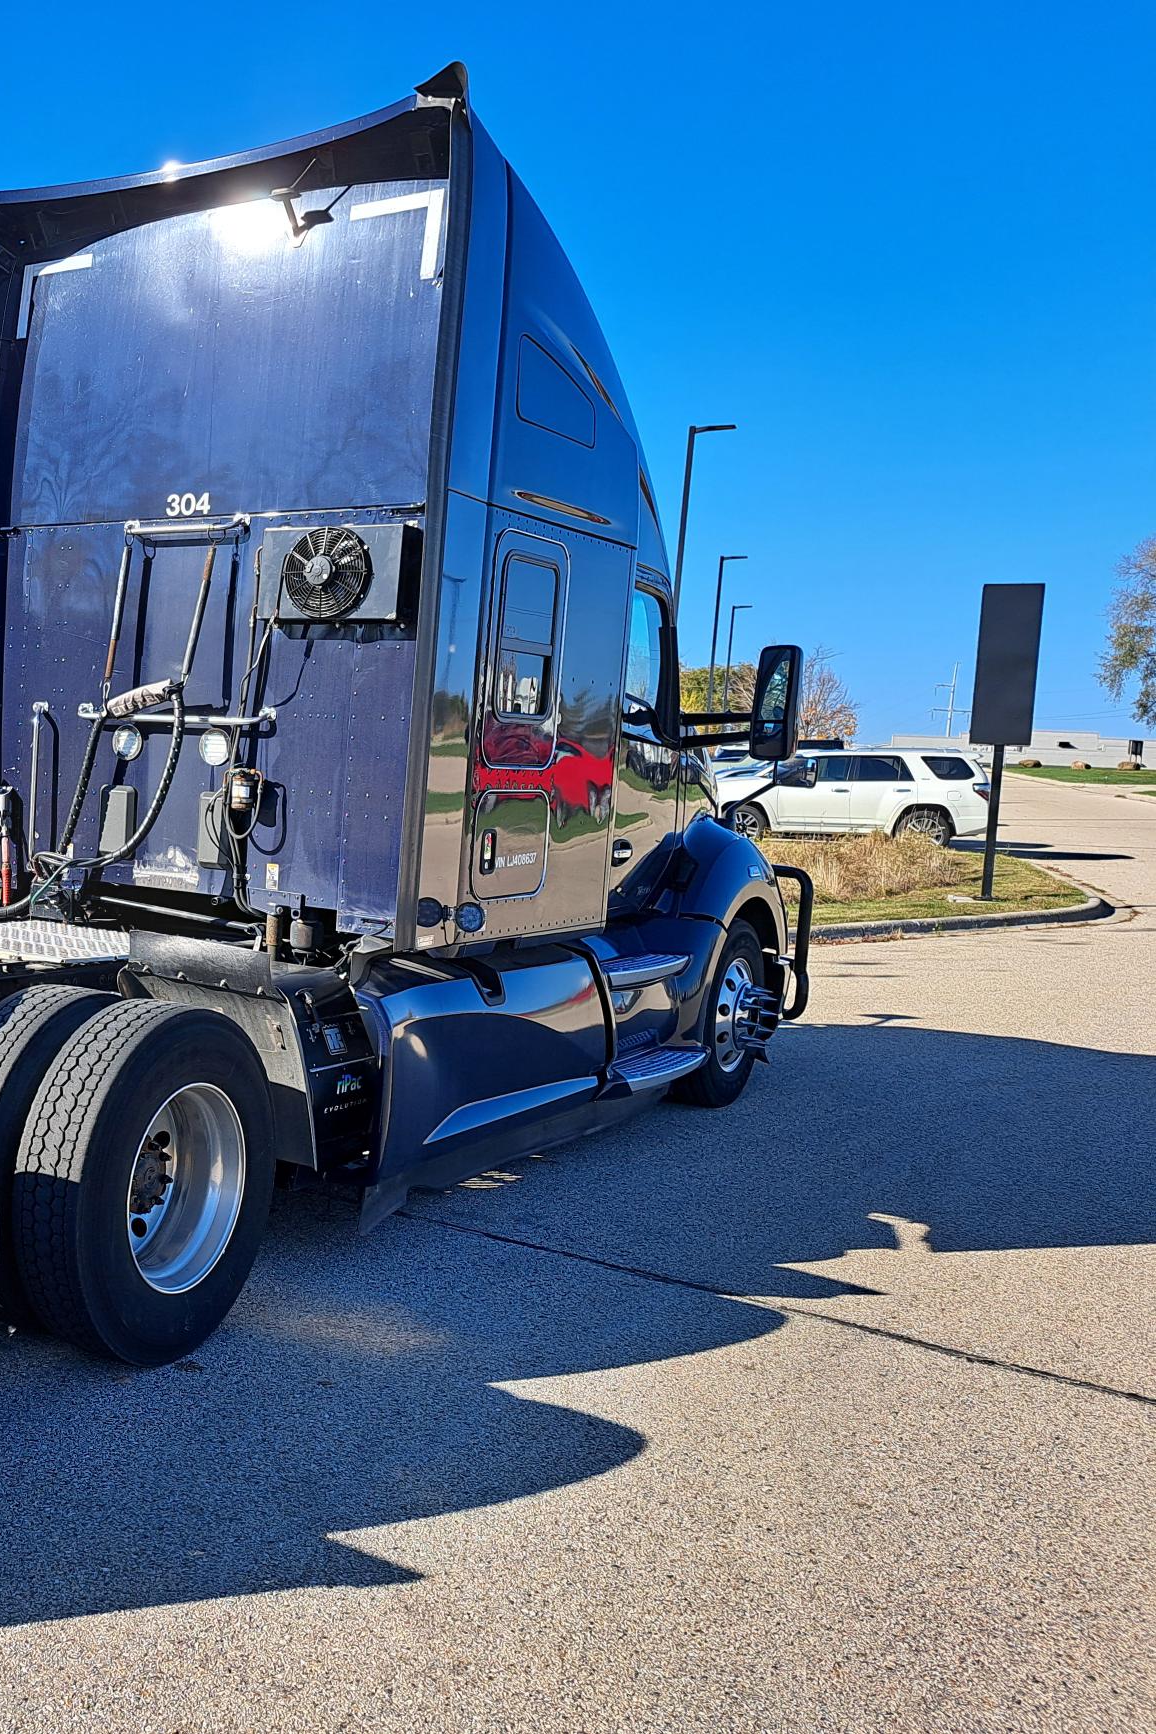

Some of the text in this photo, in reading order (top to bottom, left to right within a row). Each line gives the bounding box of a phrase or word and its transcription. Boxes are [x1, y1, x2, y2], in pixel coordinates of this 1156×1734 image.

[165, 492, 211, 517] 304
[495, 857, 505, 868] VIN
[334, 1073, 362, 1095] riPac
